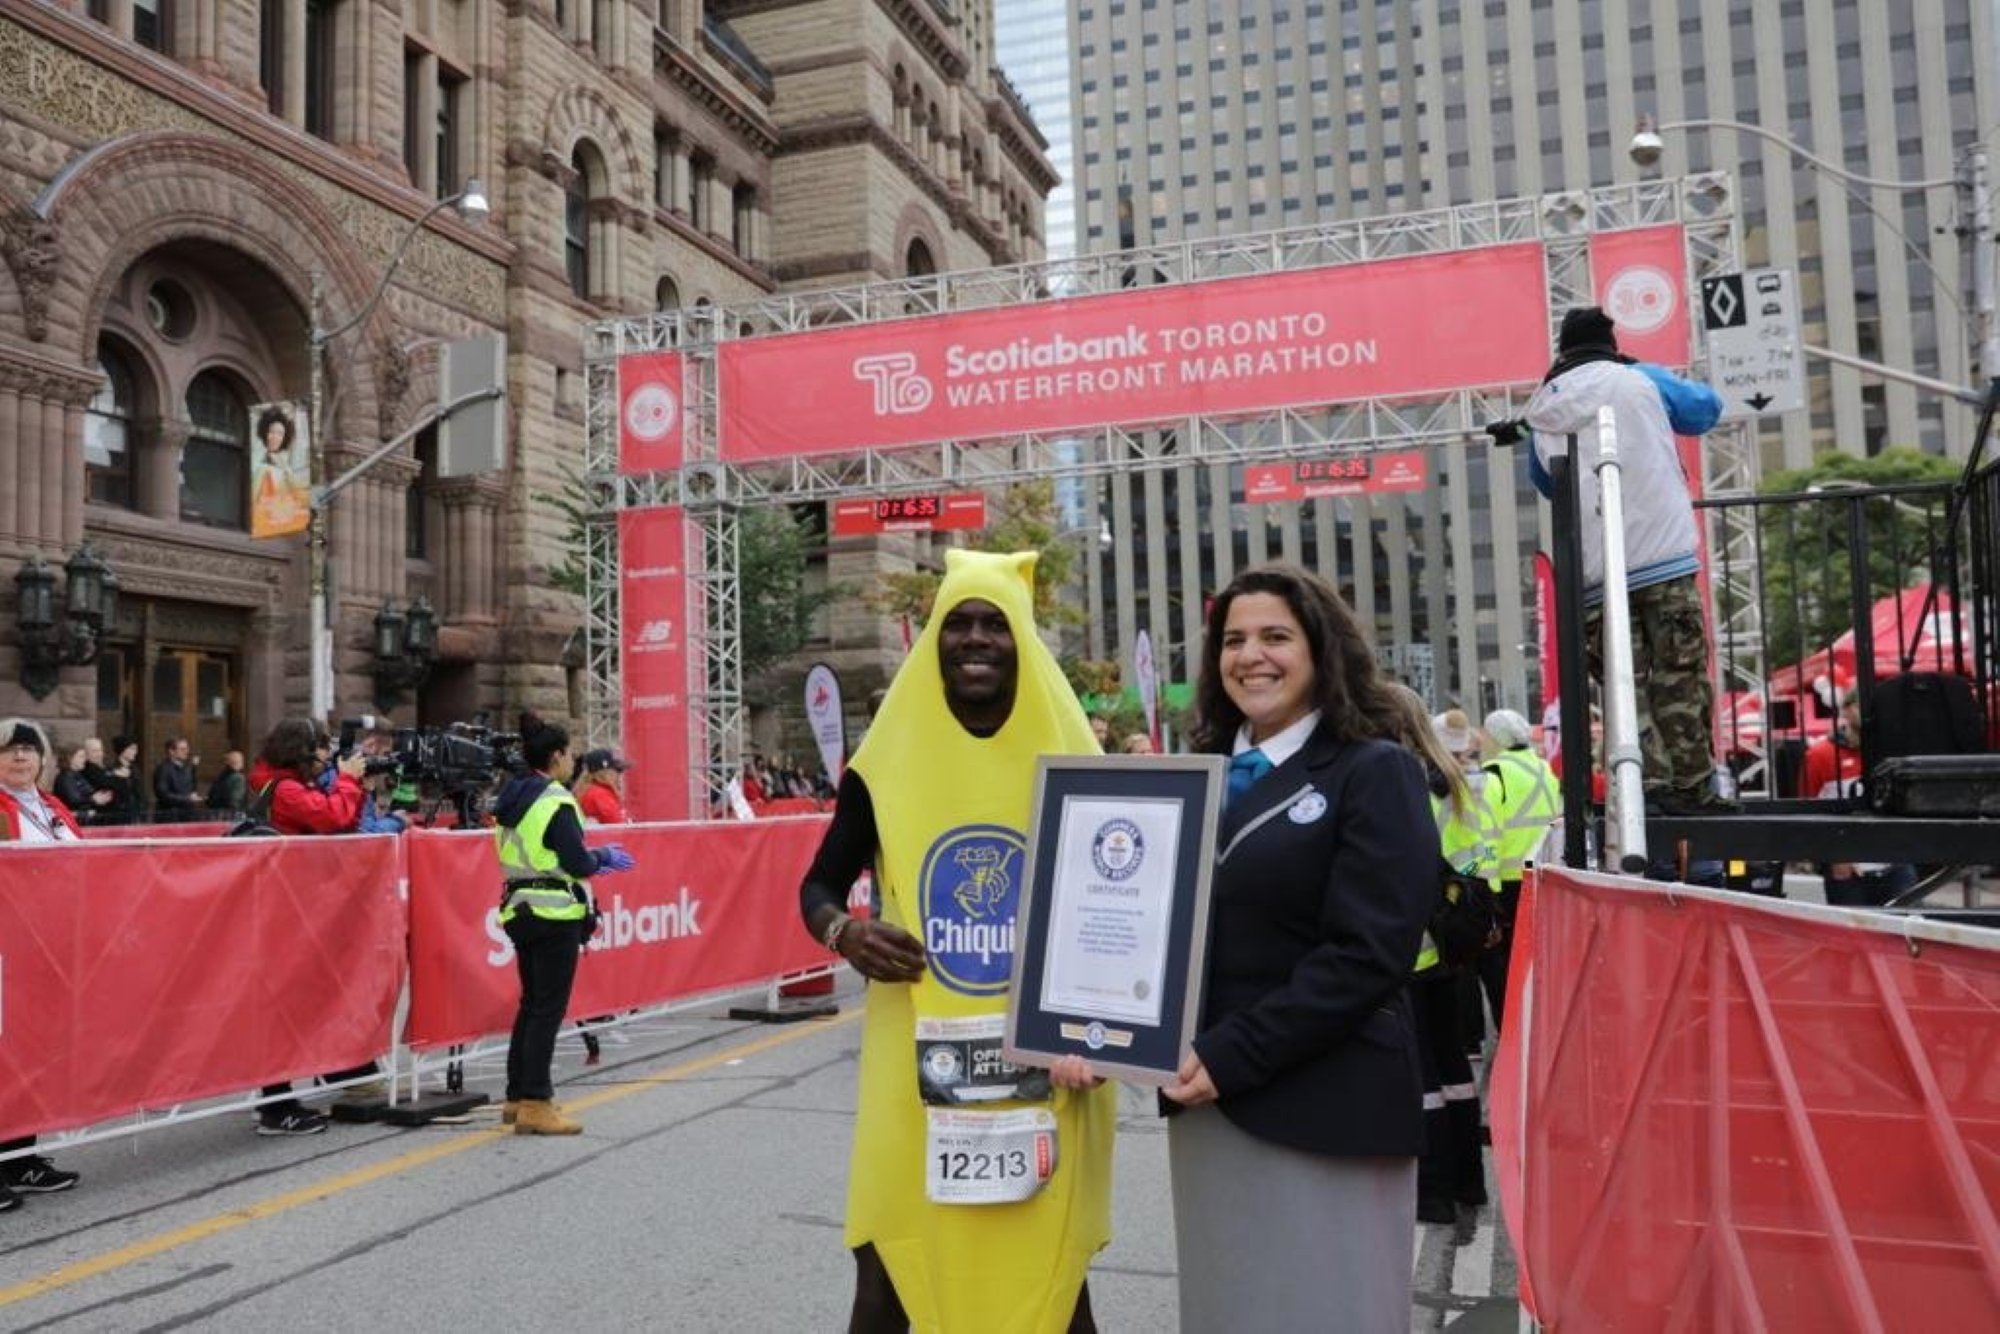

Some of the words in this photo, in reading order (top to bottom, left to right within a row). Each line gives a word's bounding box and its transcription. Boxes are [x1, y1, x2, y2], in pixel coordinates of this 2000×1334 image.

[946, 326, 1146, 377] Scotiabank
[1158, 312, 1326, 353] TORONTO
[947, 362, 1167, 408] WATERFRONT
[1180, 339, 1378, 384] MARATHON
[484, 886, 702, 967] Sabank
[926, 915, 1016, 965] Chiqui
[938, 1151, 1028, 1180] 12213
